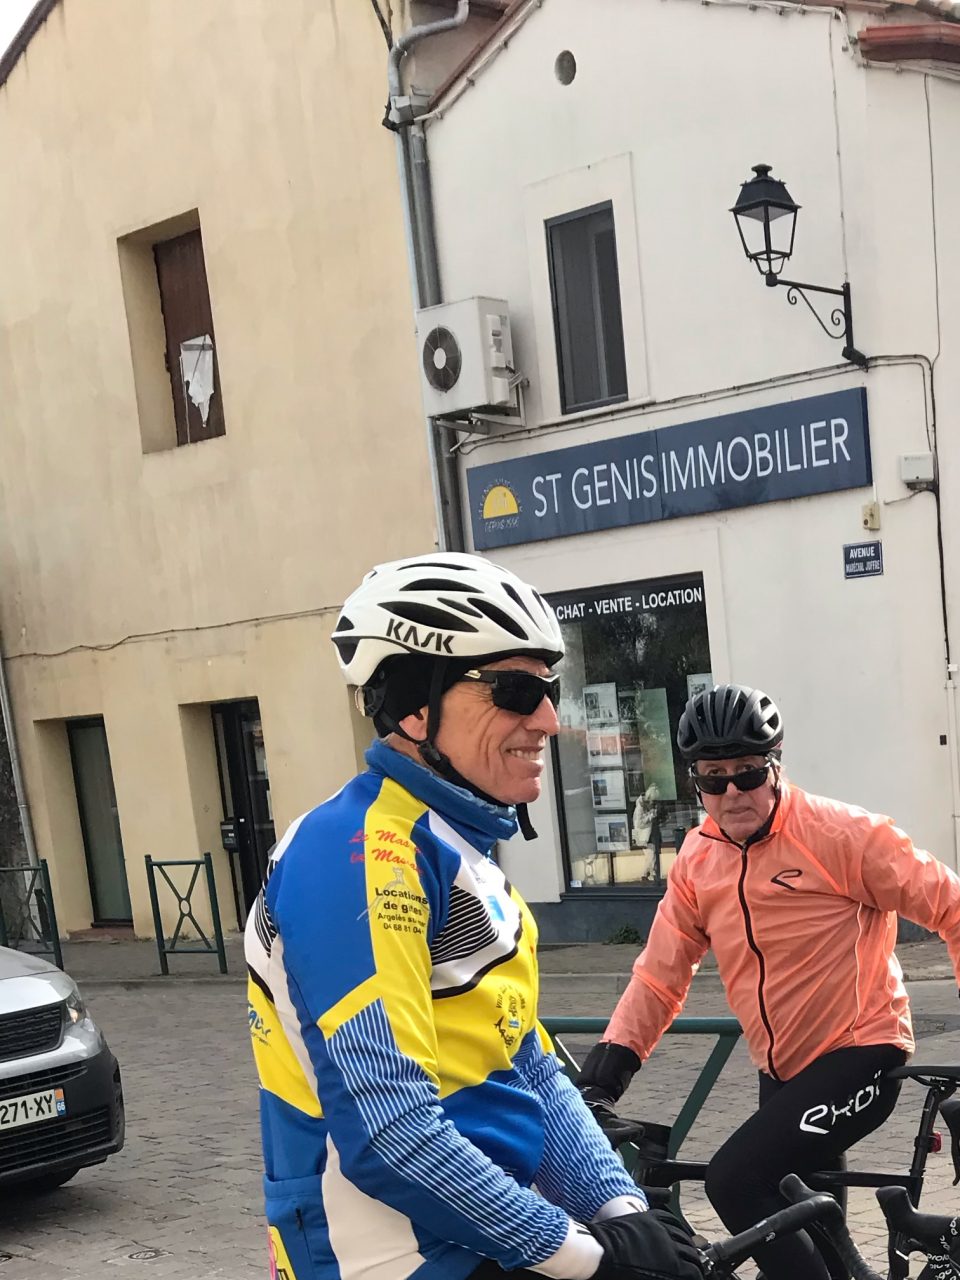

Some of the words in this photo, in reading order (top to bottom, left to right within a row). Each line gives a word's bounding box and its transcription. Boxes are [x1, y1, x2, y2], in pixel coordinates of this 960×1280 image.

[532, 472, 562, 518] ST
[571, 454, 658, 511] GENIS
[661, 416, 852, 494] IMMOBILIER
[850, 546, 876, 559] AVENUE
[594, 597, 633, 615] VENTE
[642, 587, 703, 609] LOCATION
[386, 618, 455, 654] KASK
[375, 887, 429, 905] Locations
[383, 901, 398, 910] de
